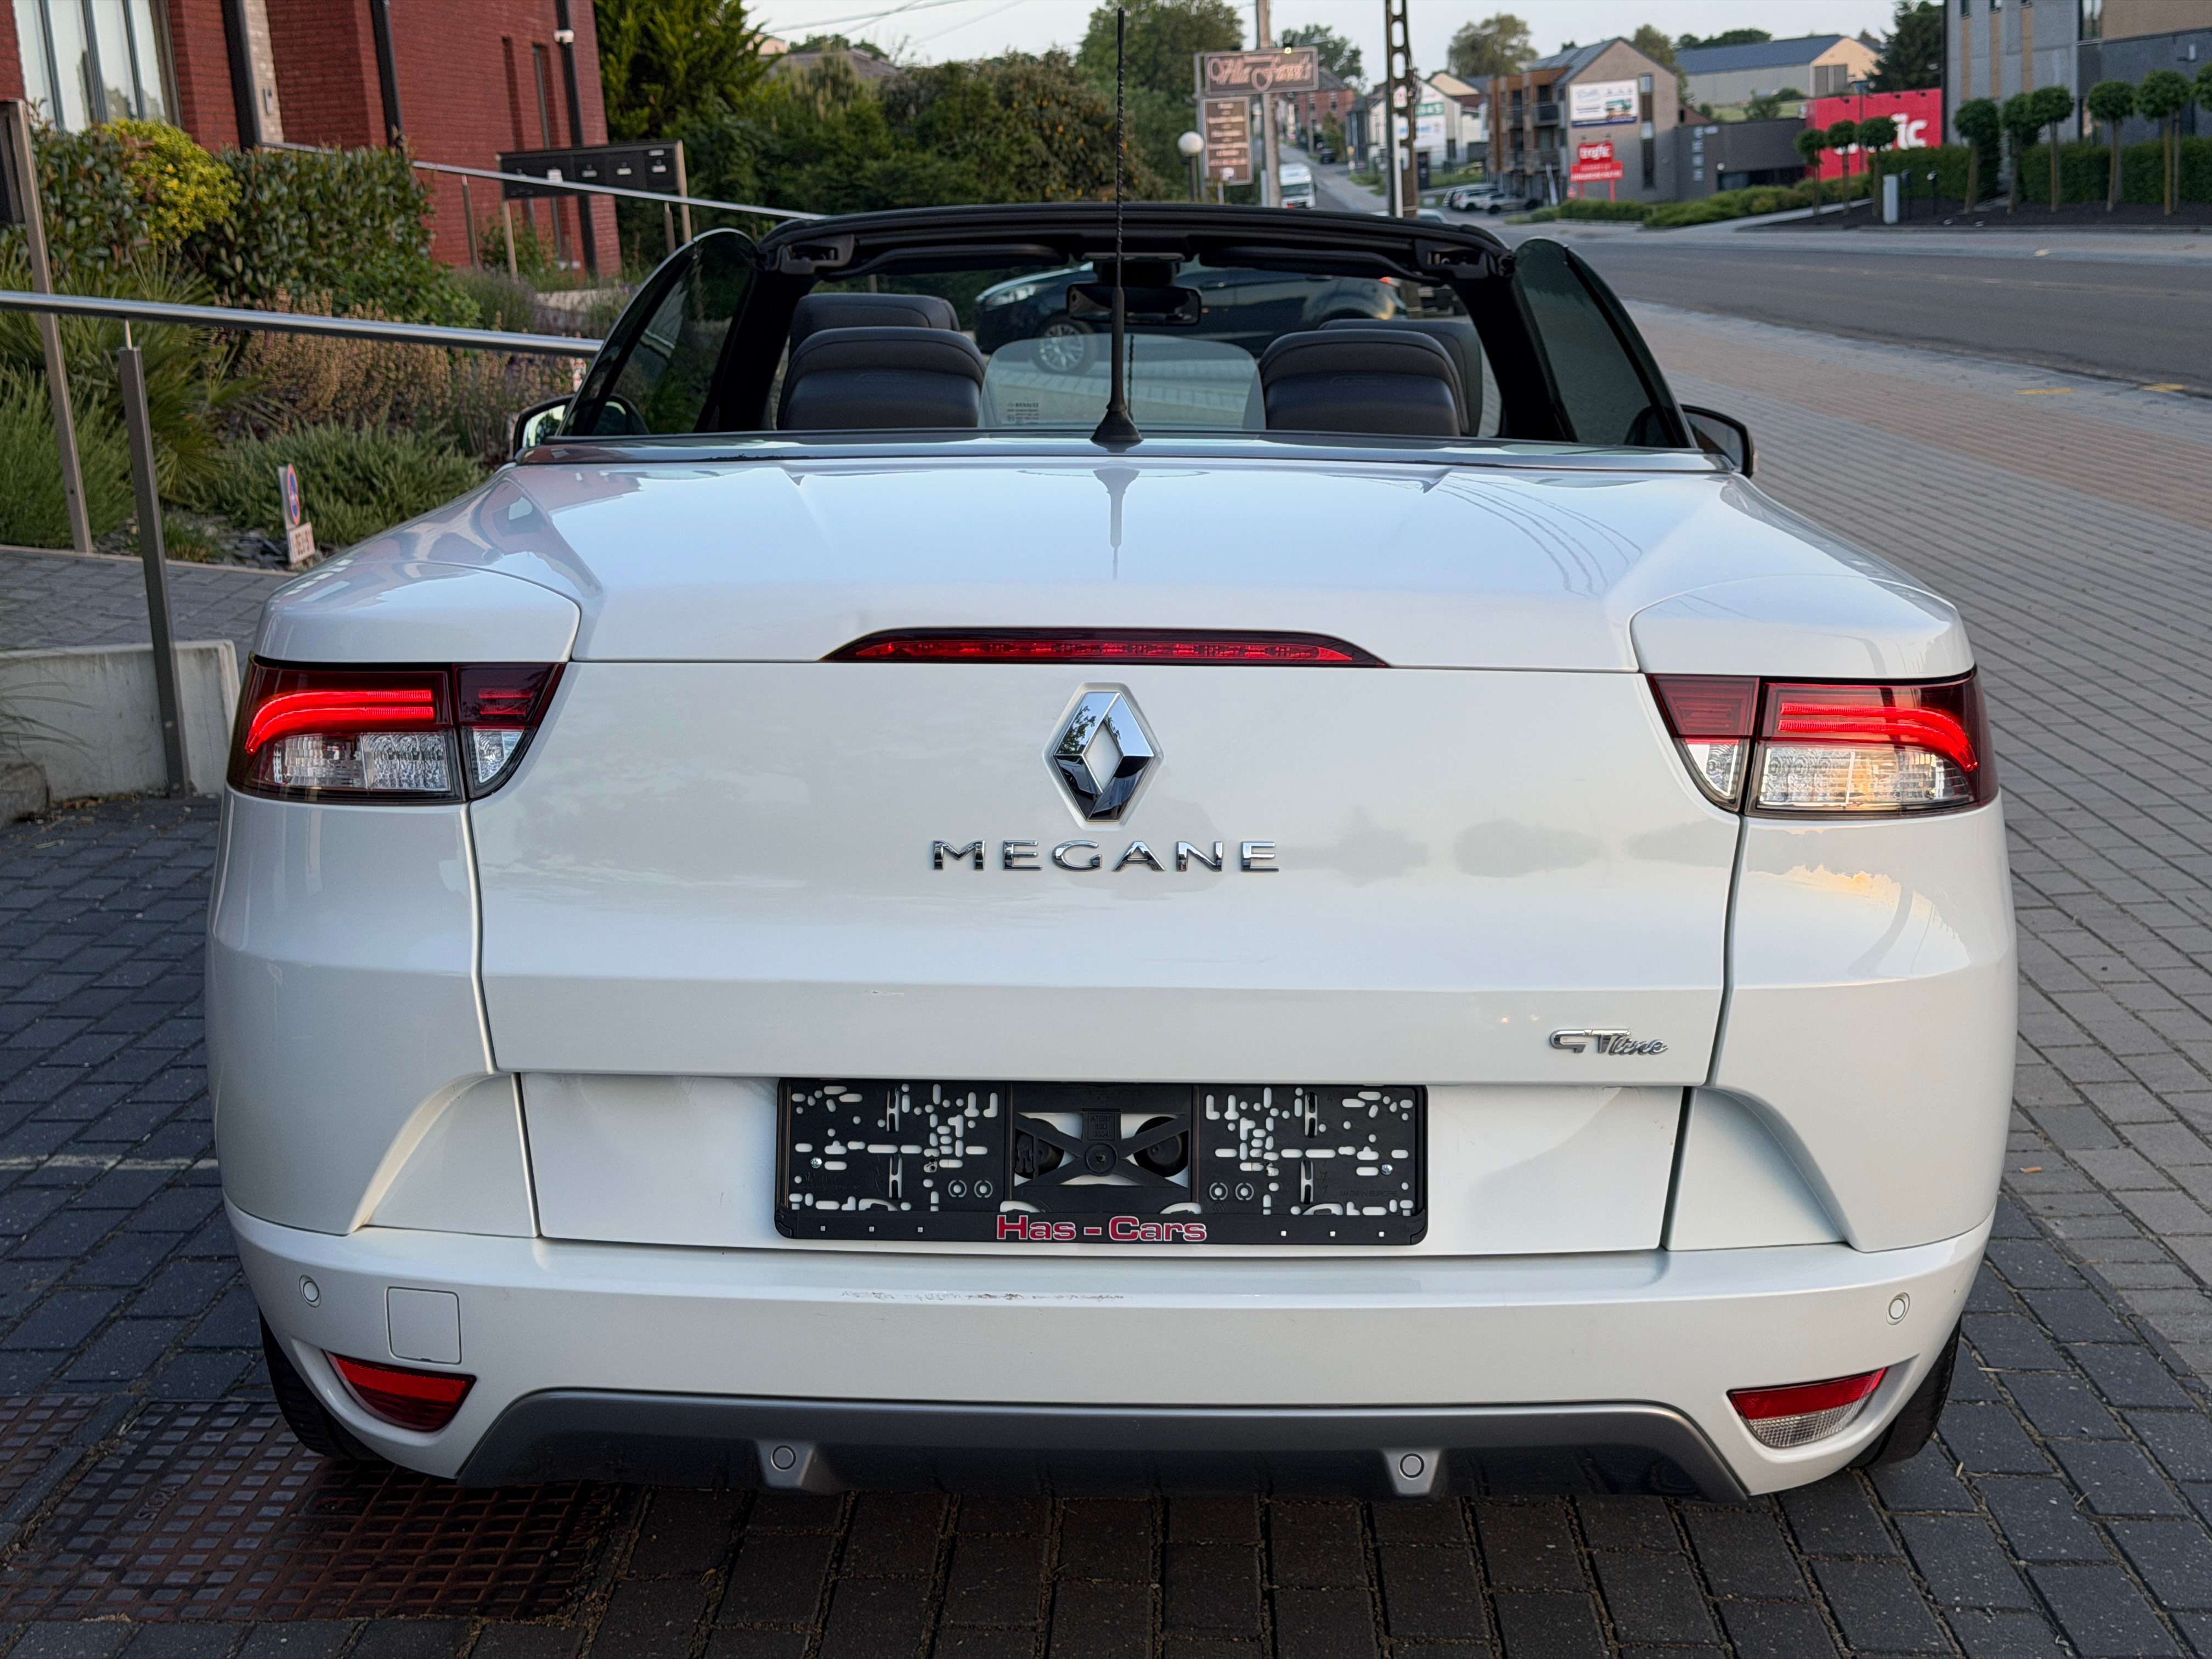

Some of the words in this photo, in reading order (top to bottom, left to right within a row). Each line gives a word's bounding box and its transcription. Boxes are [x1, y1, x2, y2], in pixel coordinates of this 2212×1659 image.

[933, 839, 1279, 872] MEGANE
[997, 1215, 1075, 1240] Has
[1109, 1216, 1207, 1242] Cars
